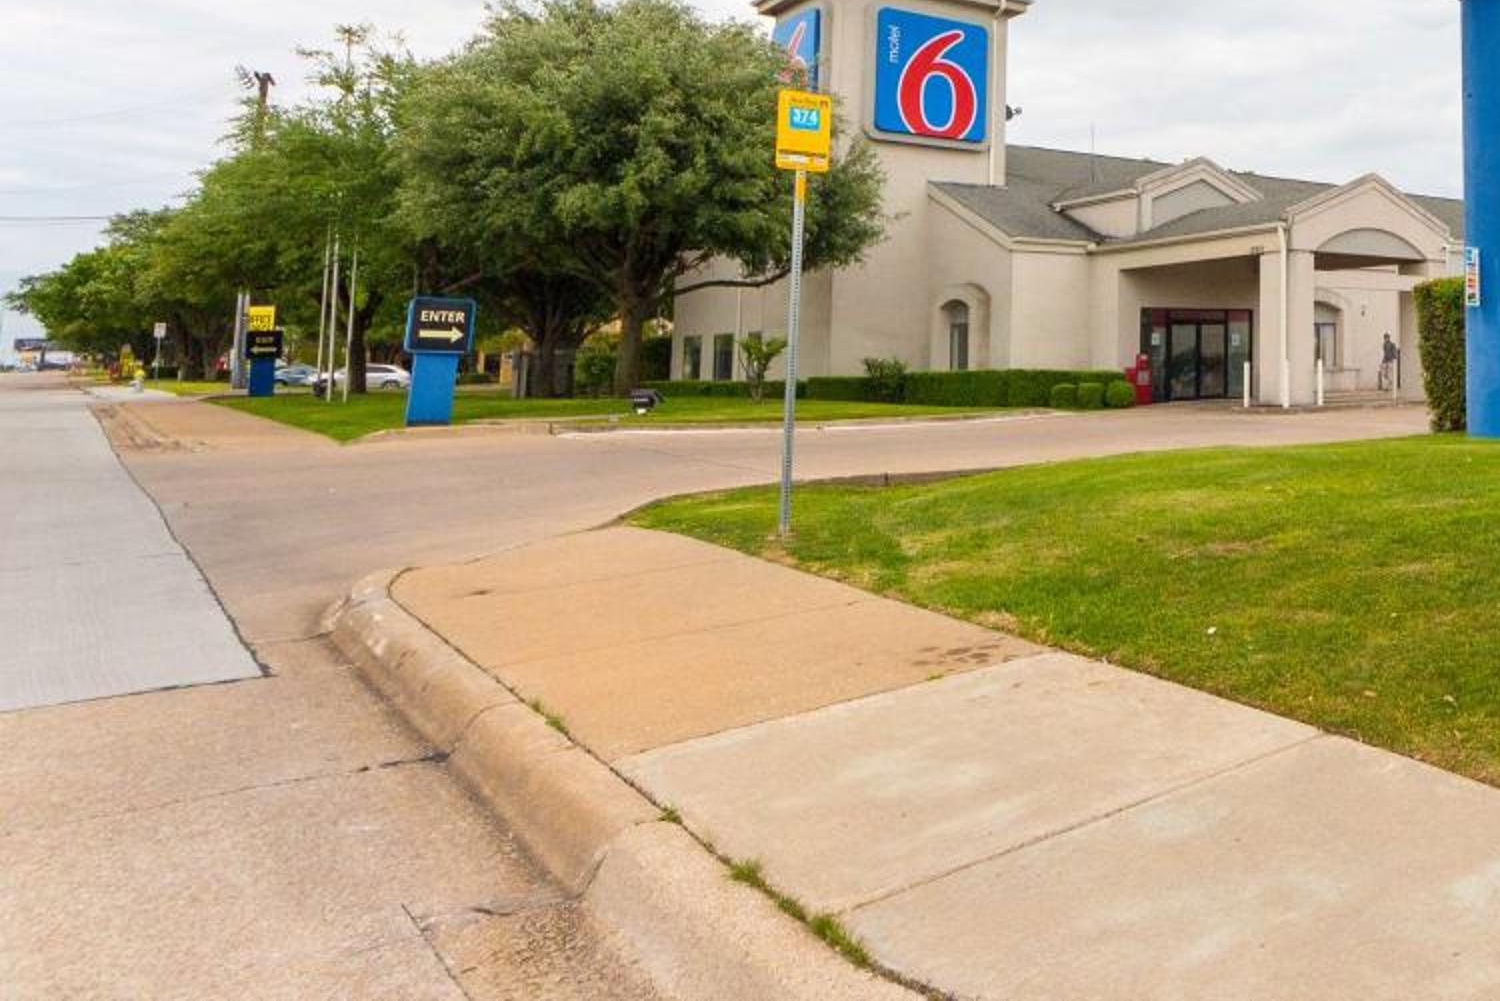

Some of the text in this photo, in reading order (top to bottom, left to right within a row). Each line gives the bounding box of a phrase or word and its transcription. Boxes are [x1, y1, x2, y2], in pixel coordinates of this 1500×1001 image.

[888, 24, 900, 63] motel
[897, 30, 978, 140] 6
[792, 108, 818, 125] 374
[421, 310, 465, 323] ENTER
